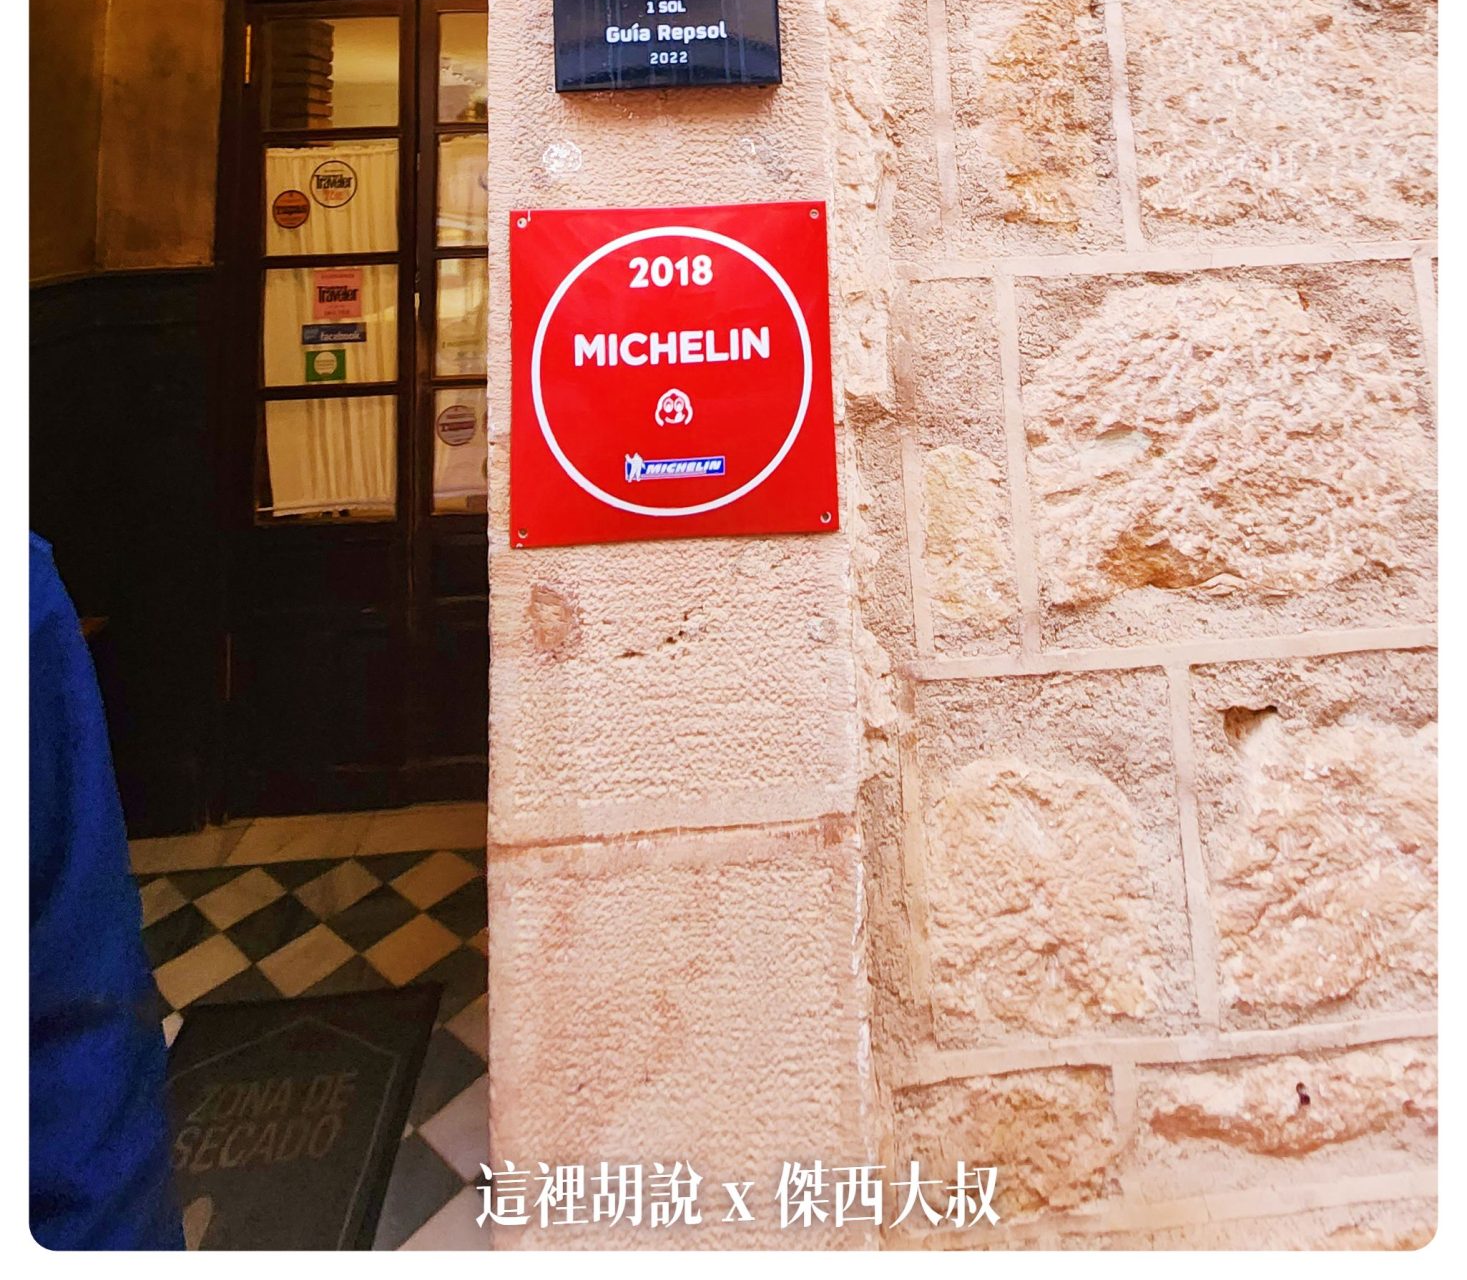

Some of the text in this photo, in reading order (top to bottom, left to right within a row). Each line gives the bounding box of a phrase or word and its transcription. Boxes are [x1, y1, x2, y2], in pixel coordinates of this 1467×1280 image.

[646, 0, 686, 14] 1 SOL
[606, 21, 727, 44] Guía Repsol
[649, 51, 688, 64] 2022
[628, 255, 713, 288] 2018
[574, 326, 770, 366] MICHELIN
[645, 460, 722, 475] MICHELIN
[173, 1113, 345, 1174] SECADO
